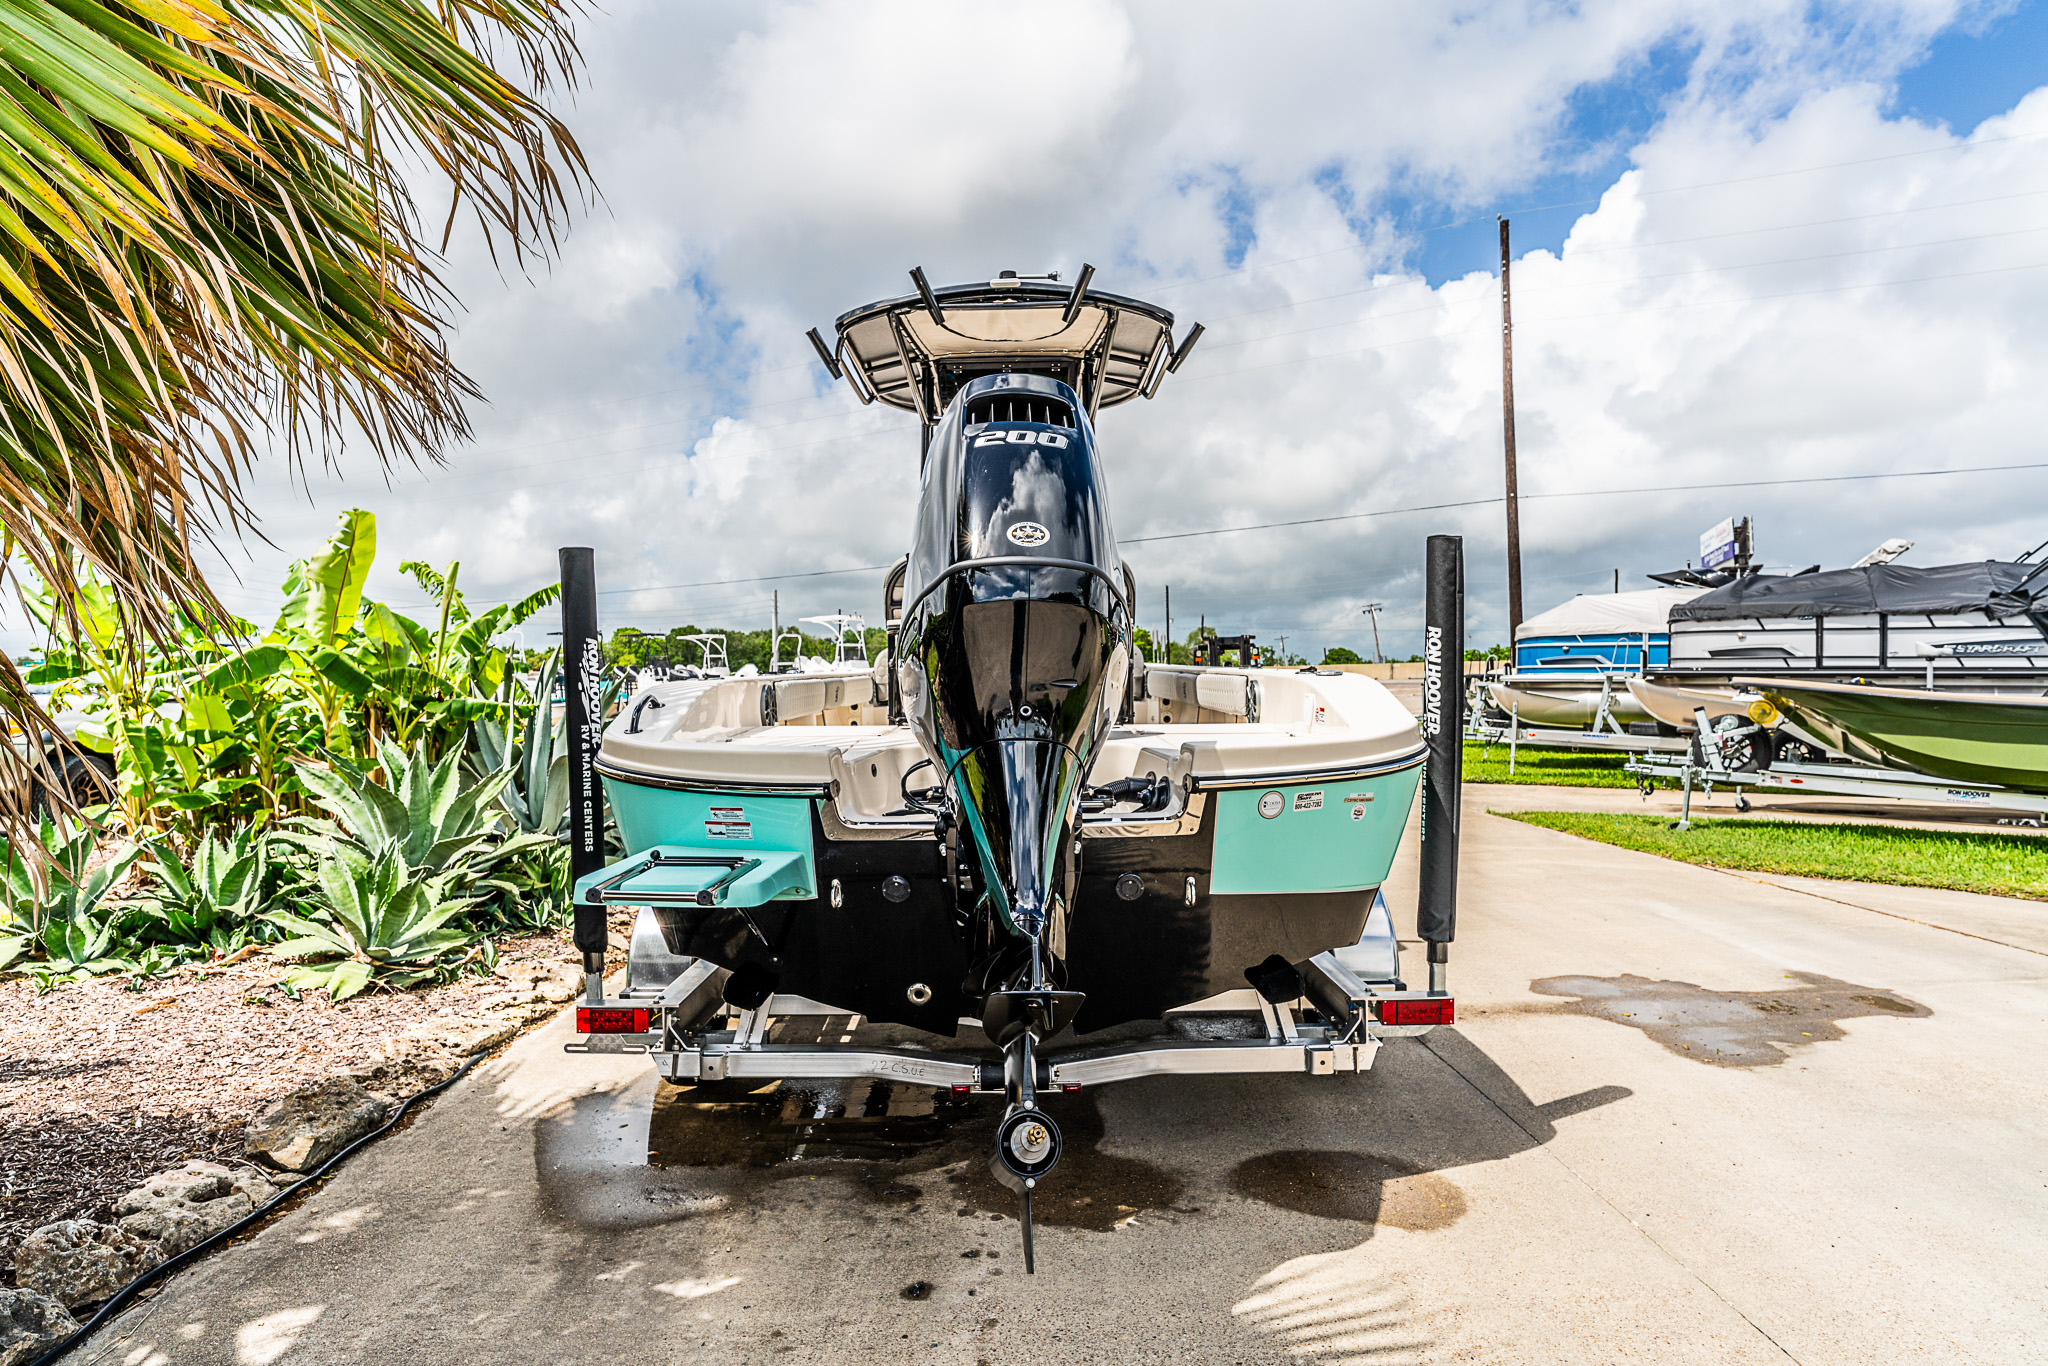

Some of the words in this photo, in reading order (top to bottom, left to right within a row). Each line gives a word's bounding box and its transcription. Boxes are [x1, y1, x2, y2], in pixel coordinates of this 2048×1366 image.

[974, 430, 1069, 449] 200
[586, 638, 599, 674] RON
[1427, 626, 1442, 663] RON
[1954, 644, 2044, 654] STARCRAFT
[589, 675, 602, 745] HOOVER
[1427, 664, 1442, 735] HOOVER
[581, 725, 590, 741] RV
[581, 742, 591, 750] &
[582, 753, 592, 797] MARINE
[1962, 790, 1990, 798] HOOVER
[583, 800, 593, 852] CENTERS
[872, 1060, 888, 1072] 22
